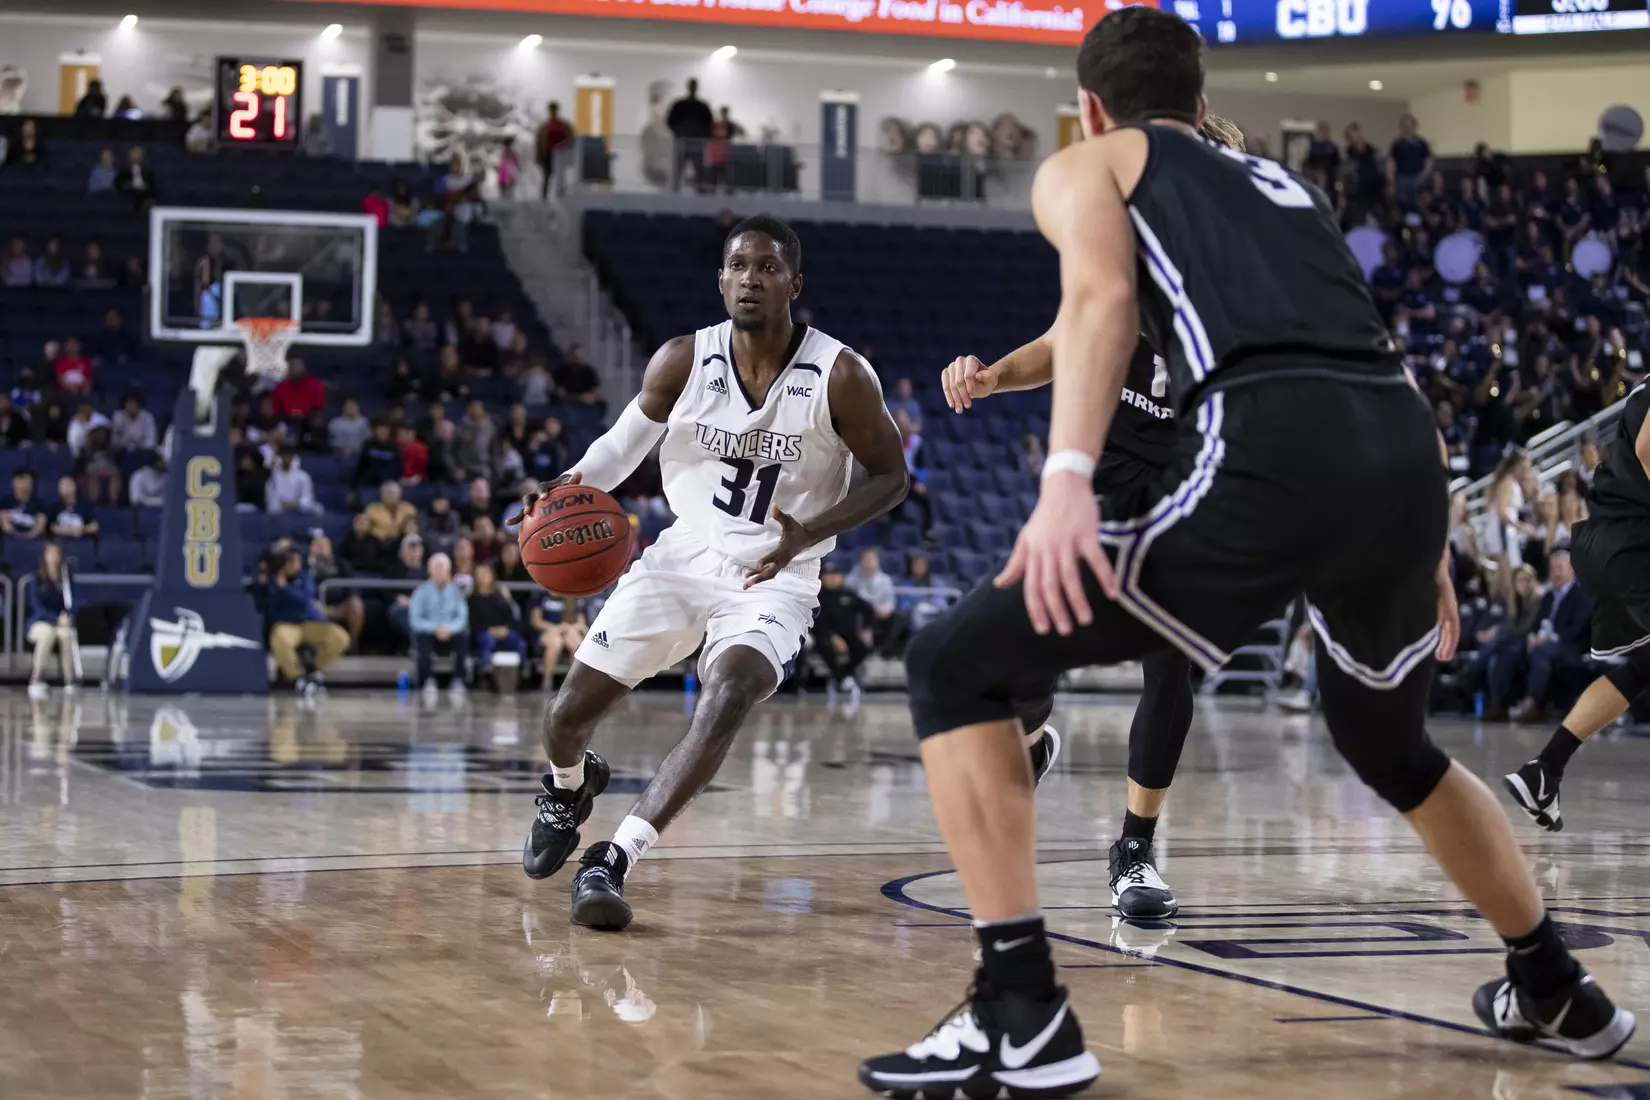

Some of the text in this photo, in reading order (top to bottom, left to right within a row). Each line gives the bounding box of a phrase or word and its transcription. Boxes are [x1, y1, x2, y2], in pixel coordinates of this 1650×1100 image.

[939, 0, 963, 24] in
[1275, 0, 1369, 39] CBU
[1430, 0, 1472, 30] 96
[239, 64, 296, 95] 3:00
[229, 91, 287, 139] 21
[787, 386, 813, 398] WAC
[694, 421, 802, 462] LANCERS
[540, 493, 595, 517] NCAA
[712, 456, 782, 525] 31
[182, 455, 222, 589] CBU
[540, 519, 616, 551] Wilson
